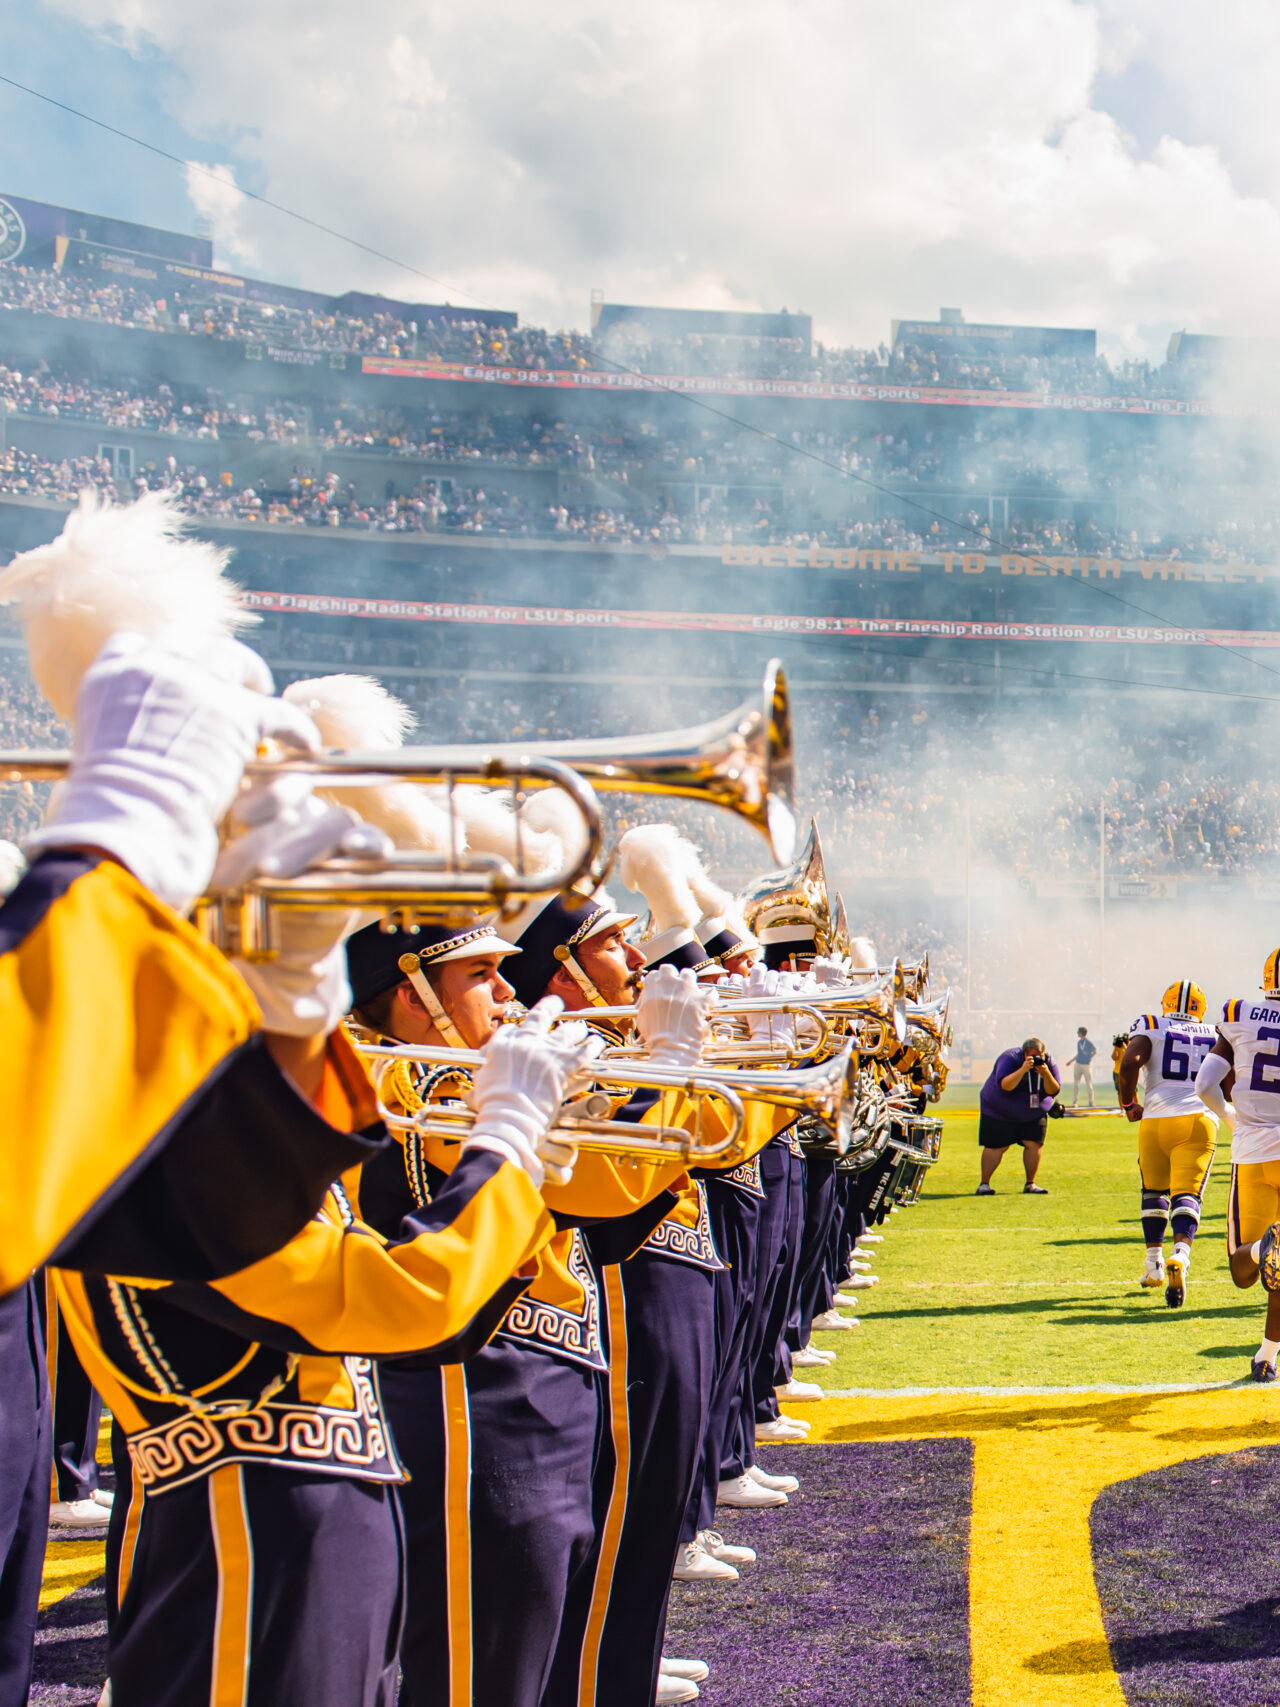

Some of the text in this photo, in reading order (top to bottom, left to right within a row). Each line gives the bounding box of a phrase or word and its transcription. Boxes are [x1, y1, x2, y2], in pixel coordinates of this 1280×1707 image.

[463, 366, 920, 401] Eagle 98.1 The Flagship Radio Station for LSU Sports
[1044, 394, 1088, 410] Eagle
[1091, 396, 1127, 410] 98.1
[1143, 399, 1173, 411] The
[721, 544, 1270, 583] WELCOME TO DEATH VALLEY
[243, 591, 621, 627] The Flagship Radio Station for LSU Sports
[752, 617, 1207, 645] Eagle 98.1 The Flagship Radio Station for LSU Sports
[1181, 1024, 1211, 1035] SMITH
[880, 1171, 892, 1187] VIC
